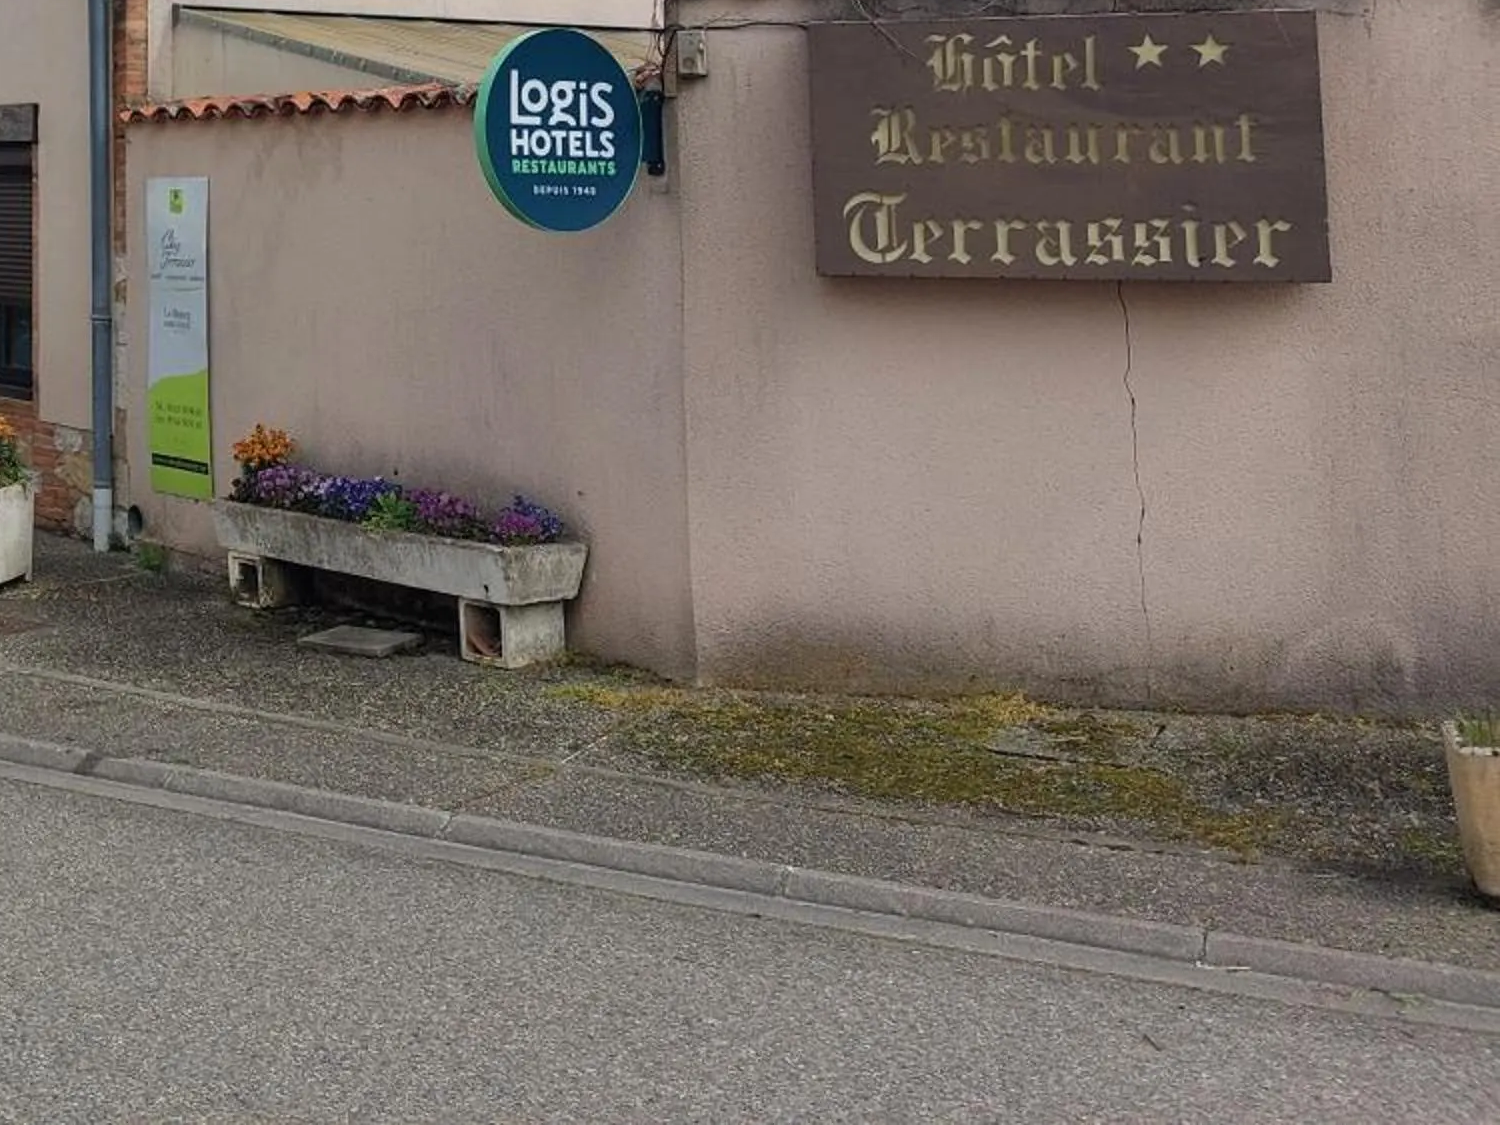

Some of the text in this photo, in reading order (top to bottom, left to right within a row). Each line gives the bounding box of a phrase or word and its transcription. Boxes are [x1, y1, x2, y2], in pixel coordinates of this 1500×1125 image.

[924, 31, 1101, 93] Hôtel
[510, 128, 616, 158] HOTELS
[870, 105, 1259, 166] Restaurant
[512, 159, 617, 175] RESTAURANTS
[842, 190, 1293, 269] Terrassier
